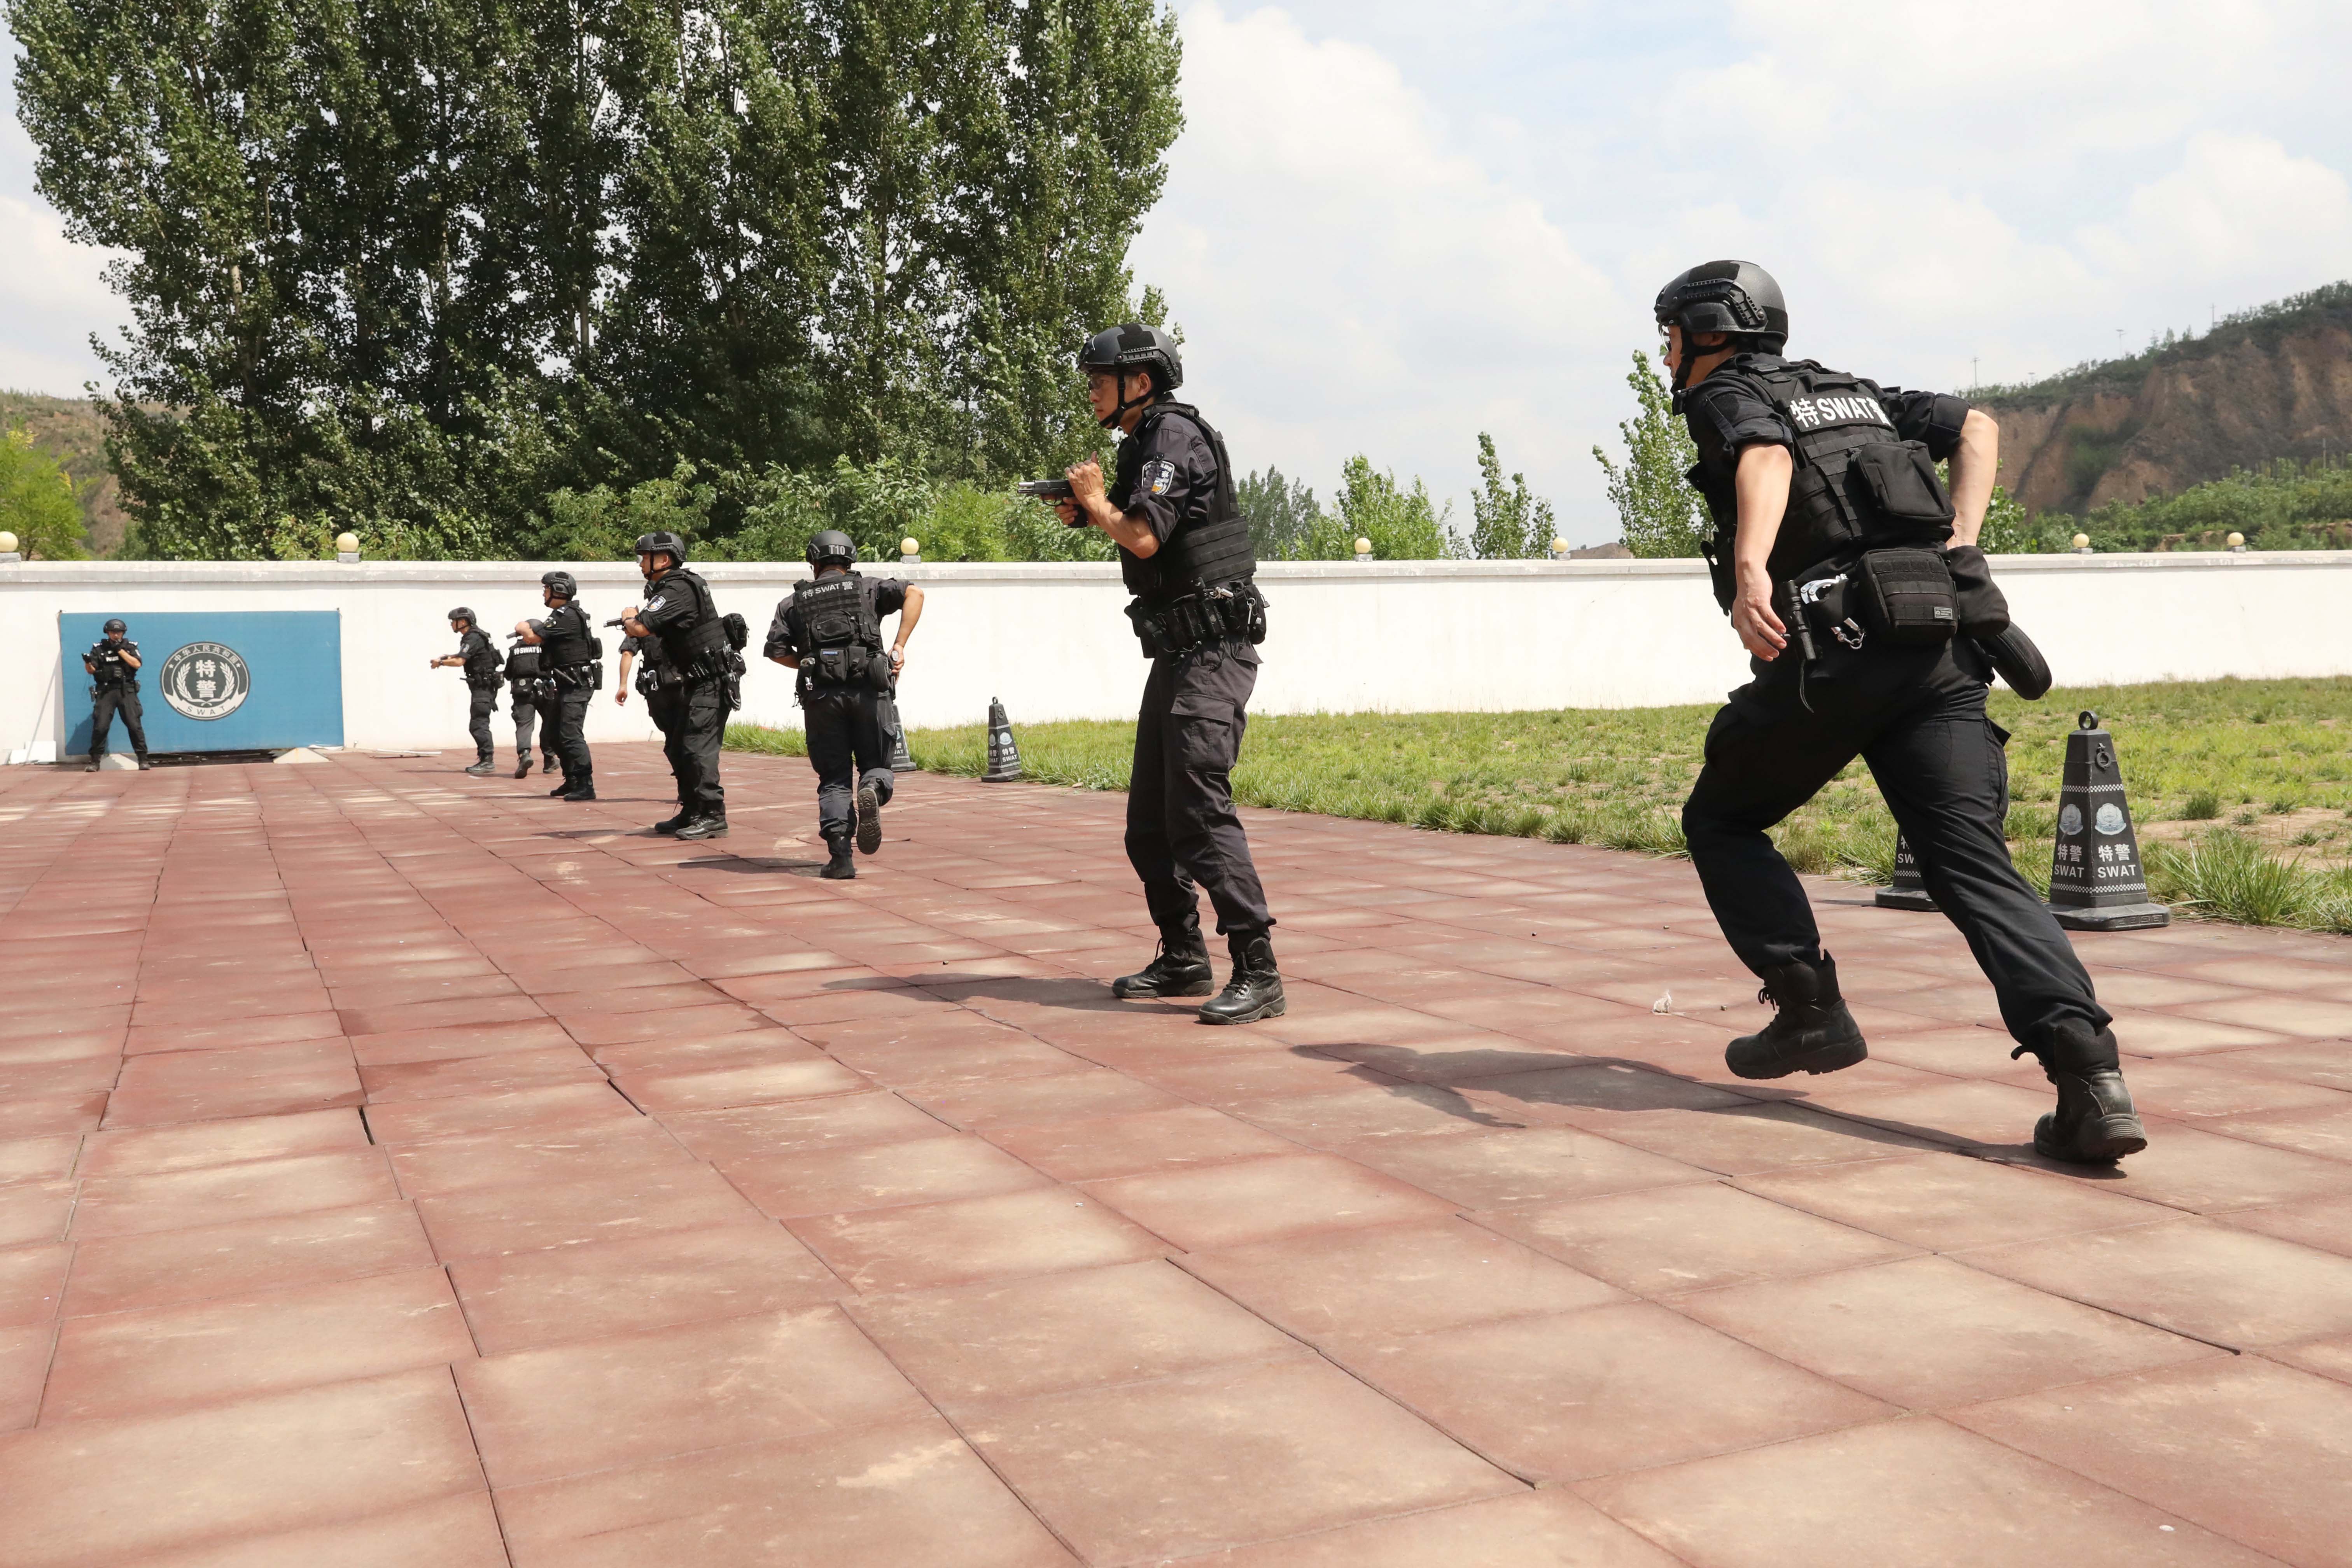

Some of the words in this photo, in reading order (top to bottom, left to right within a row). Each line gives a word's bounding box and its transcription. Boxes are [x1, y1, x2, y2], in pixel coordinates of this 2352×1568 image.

[1790, 398, 1820, 427] 特
[1816, 397, 1874, 421] SWAT
[828, 545, 845, 555] T10
[802, 589, 814, 599] 特
[815, 583, 840, 594] SWAT
[174, 645, 239, 663] 中华人民共和国
[196, 660, 217, 698] 特警
[186, 705, 226, 716] SWAT
[1898, 853, 1914, 864] SW
[2057, 844, 2082, 862] 特警
[2098, 843, 2131, 862] 特警
[2054, 864, 2084, 878] SWAT
[2097, 864, 2136, 878] SWAT
